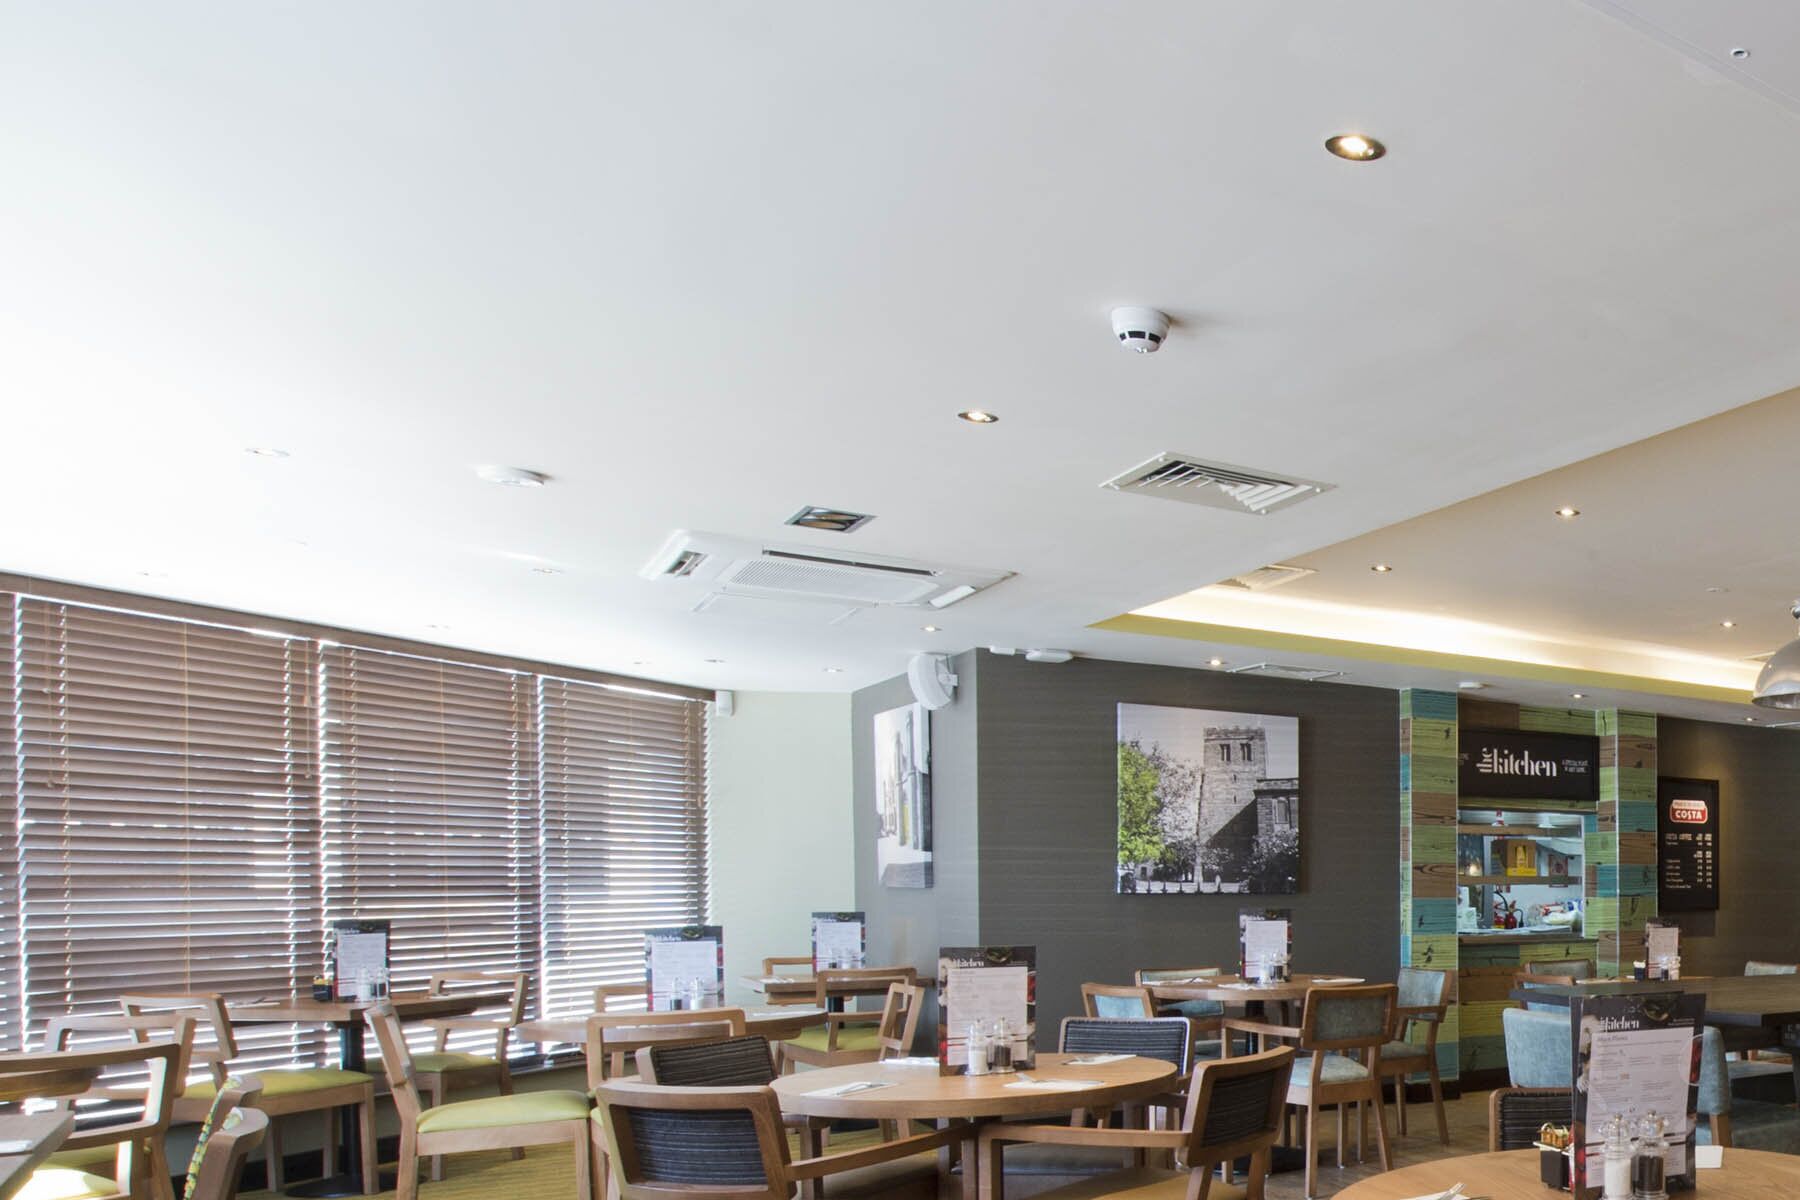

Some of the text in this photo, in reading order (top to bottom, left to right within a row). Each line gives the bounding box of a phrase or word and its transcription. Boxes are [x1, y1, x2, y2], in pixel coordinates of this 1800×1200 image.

[1493, 748, 1557, 777] kitchen
[1675, 810, 1702, 820] COSTA
[1606, 1015, 1639, 1032] kitchen
